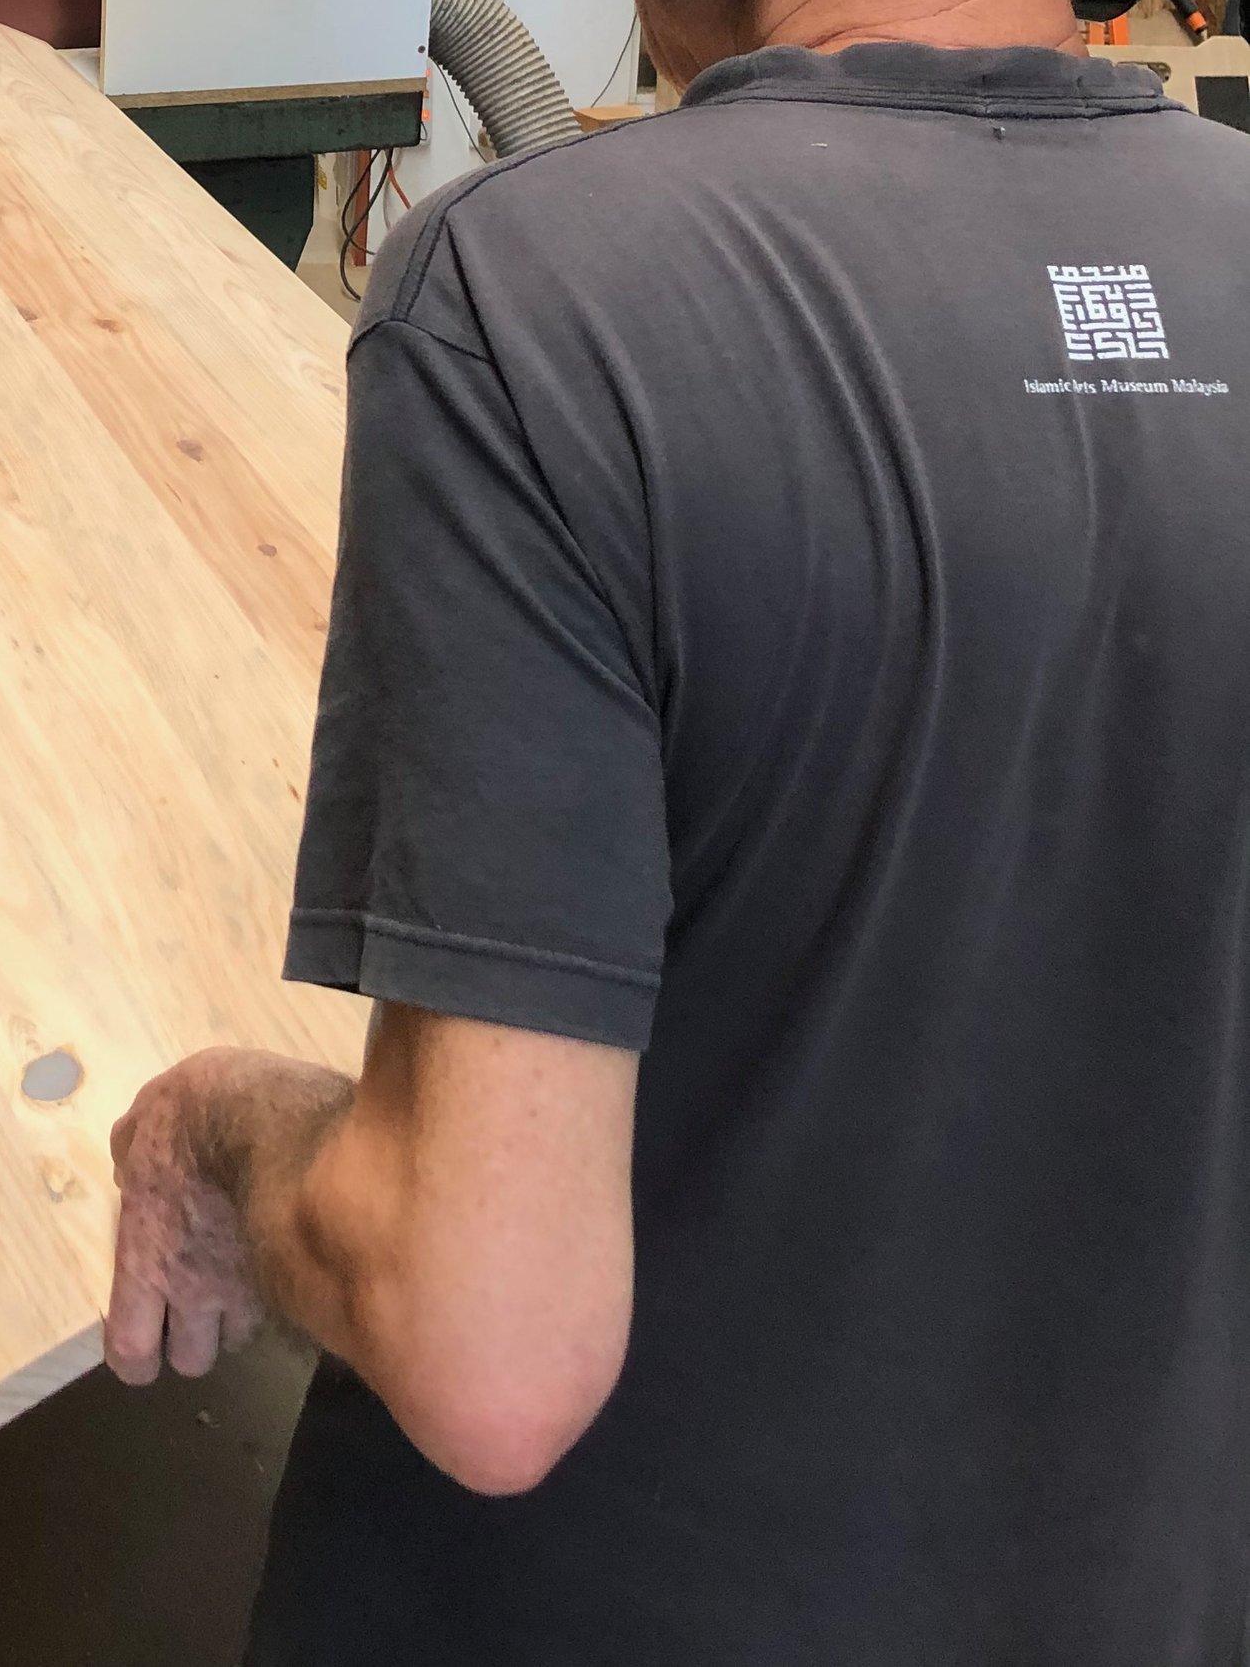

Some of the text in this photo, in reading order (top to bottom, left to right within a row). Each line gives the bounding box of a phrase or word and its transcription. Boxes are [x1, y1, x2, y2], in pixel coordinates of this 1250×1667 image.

[1023, 378, 1072, 394] Islamic
[1100, 378, 1170, 394] Museum
[1171, 378, 1229, 396] Malaysia
